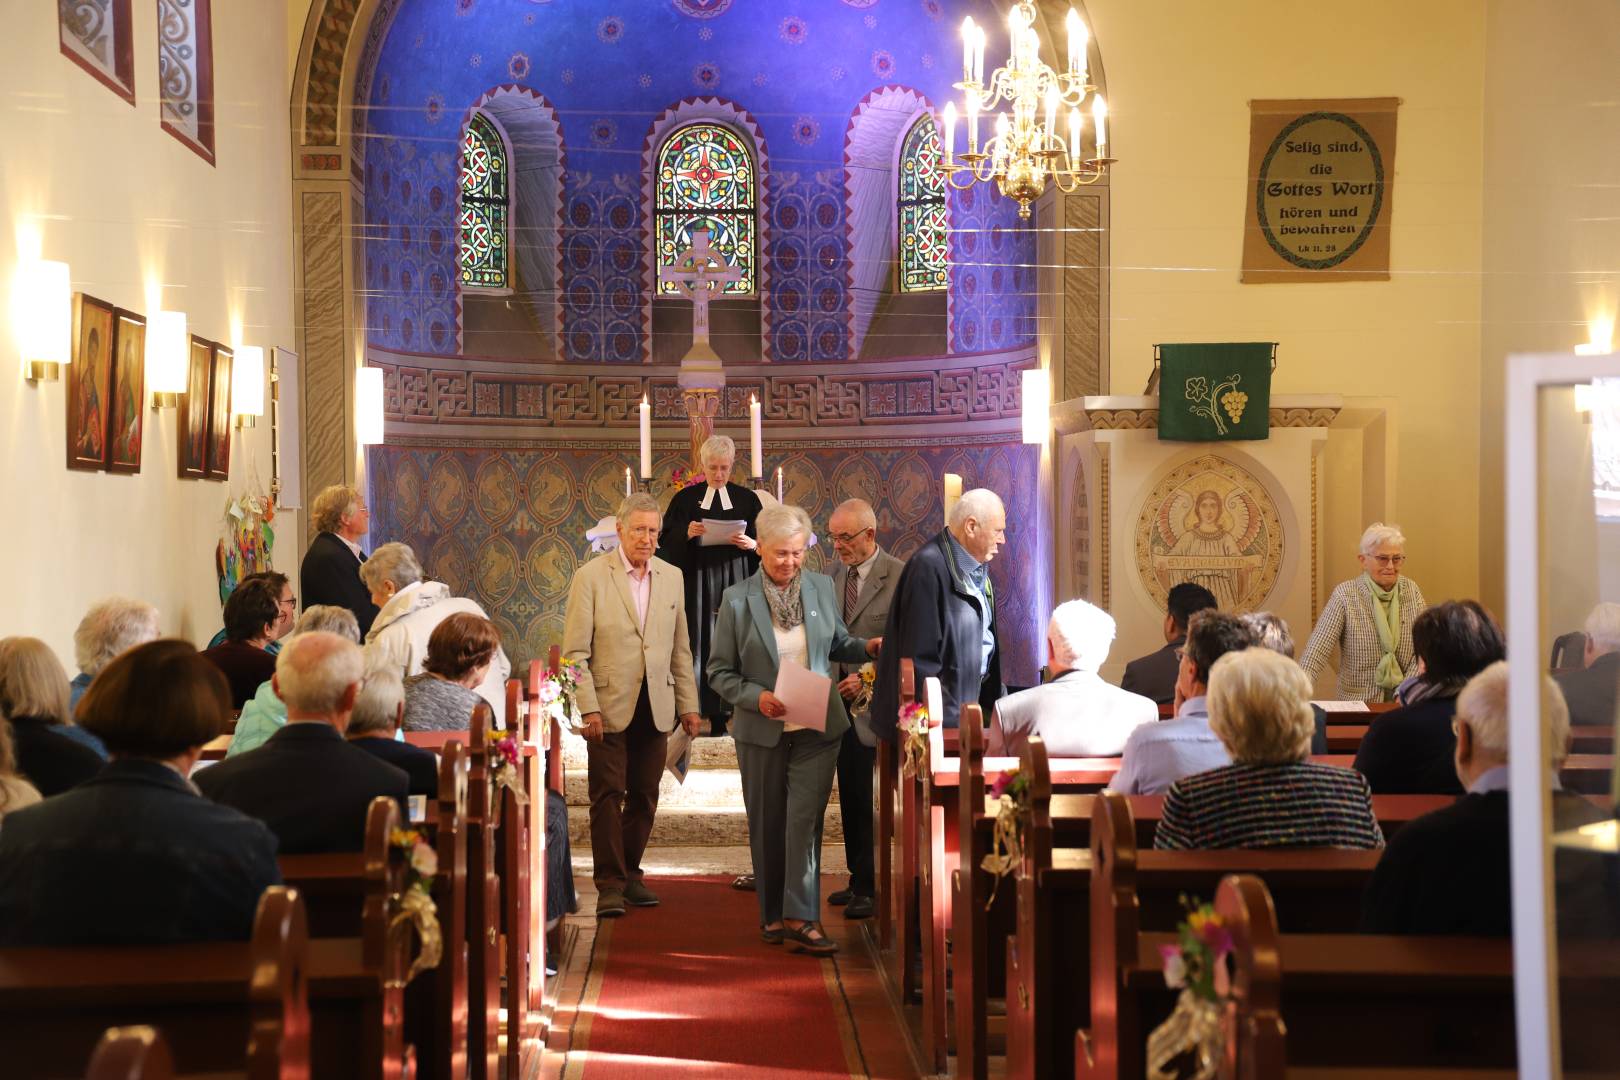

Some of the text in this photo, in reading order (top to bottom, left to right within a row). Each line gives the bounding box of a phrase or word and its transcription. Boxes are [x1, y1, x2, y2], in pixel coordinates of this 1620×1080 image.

[1286, 141, 1322, 155] Selig
[1310, 164, 1332, 175] die
[1267, 182, 1374, 197] Gottes Wort
[1280, 206, 1358, 219] hören und
[1280, 223, 1356, 235] bewahren
